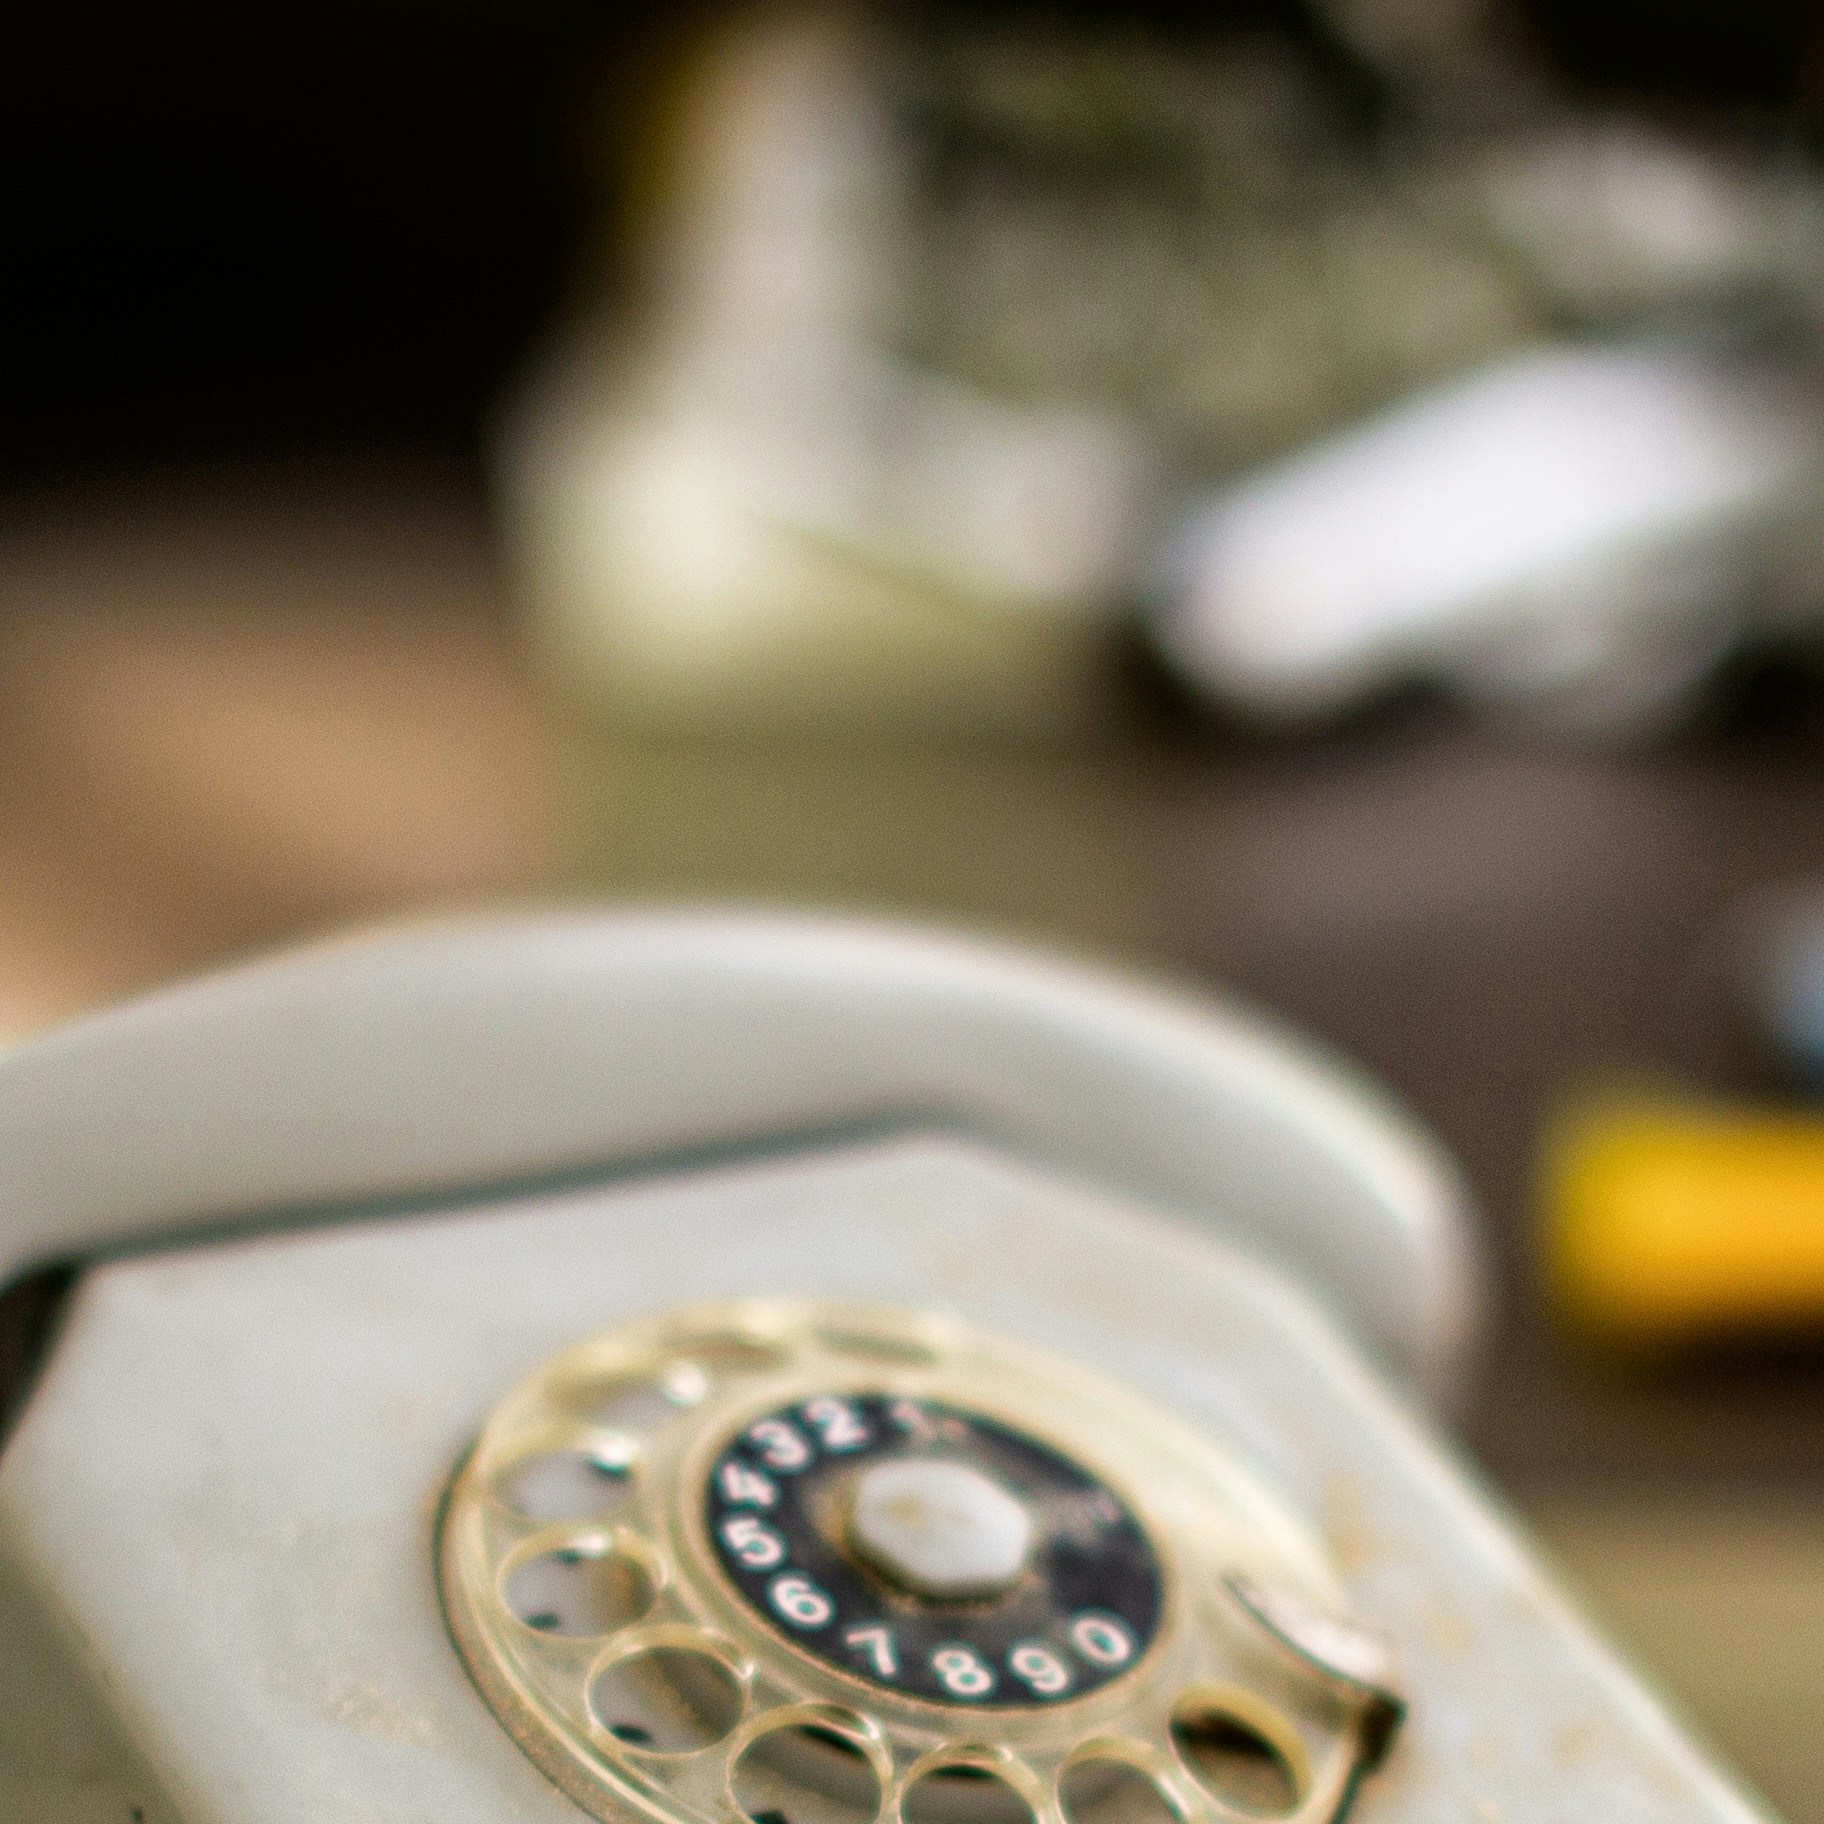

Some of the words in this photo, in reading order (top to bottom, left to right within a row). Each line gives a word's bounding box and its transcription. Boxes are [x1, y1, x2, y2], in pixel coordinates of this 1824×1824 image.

[749, 1419, 811, 1470] 3
[805, 1397, 867, 1450] 2
[719, 1463, 776, 1509] 4
[722, 1516, 784, 1569] 5
[770, 1575, 833, 1627] 6
[844, 1625, 899, 1678] 7
[1071, 1613, 1135, 1667] 0
[931, 1647, 994, 1696] 8
[1009, 1644, 1070, 1695] 9
